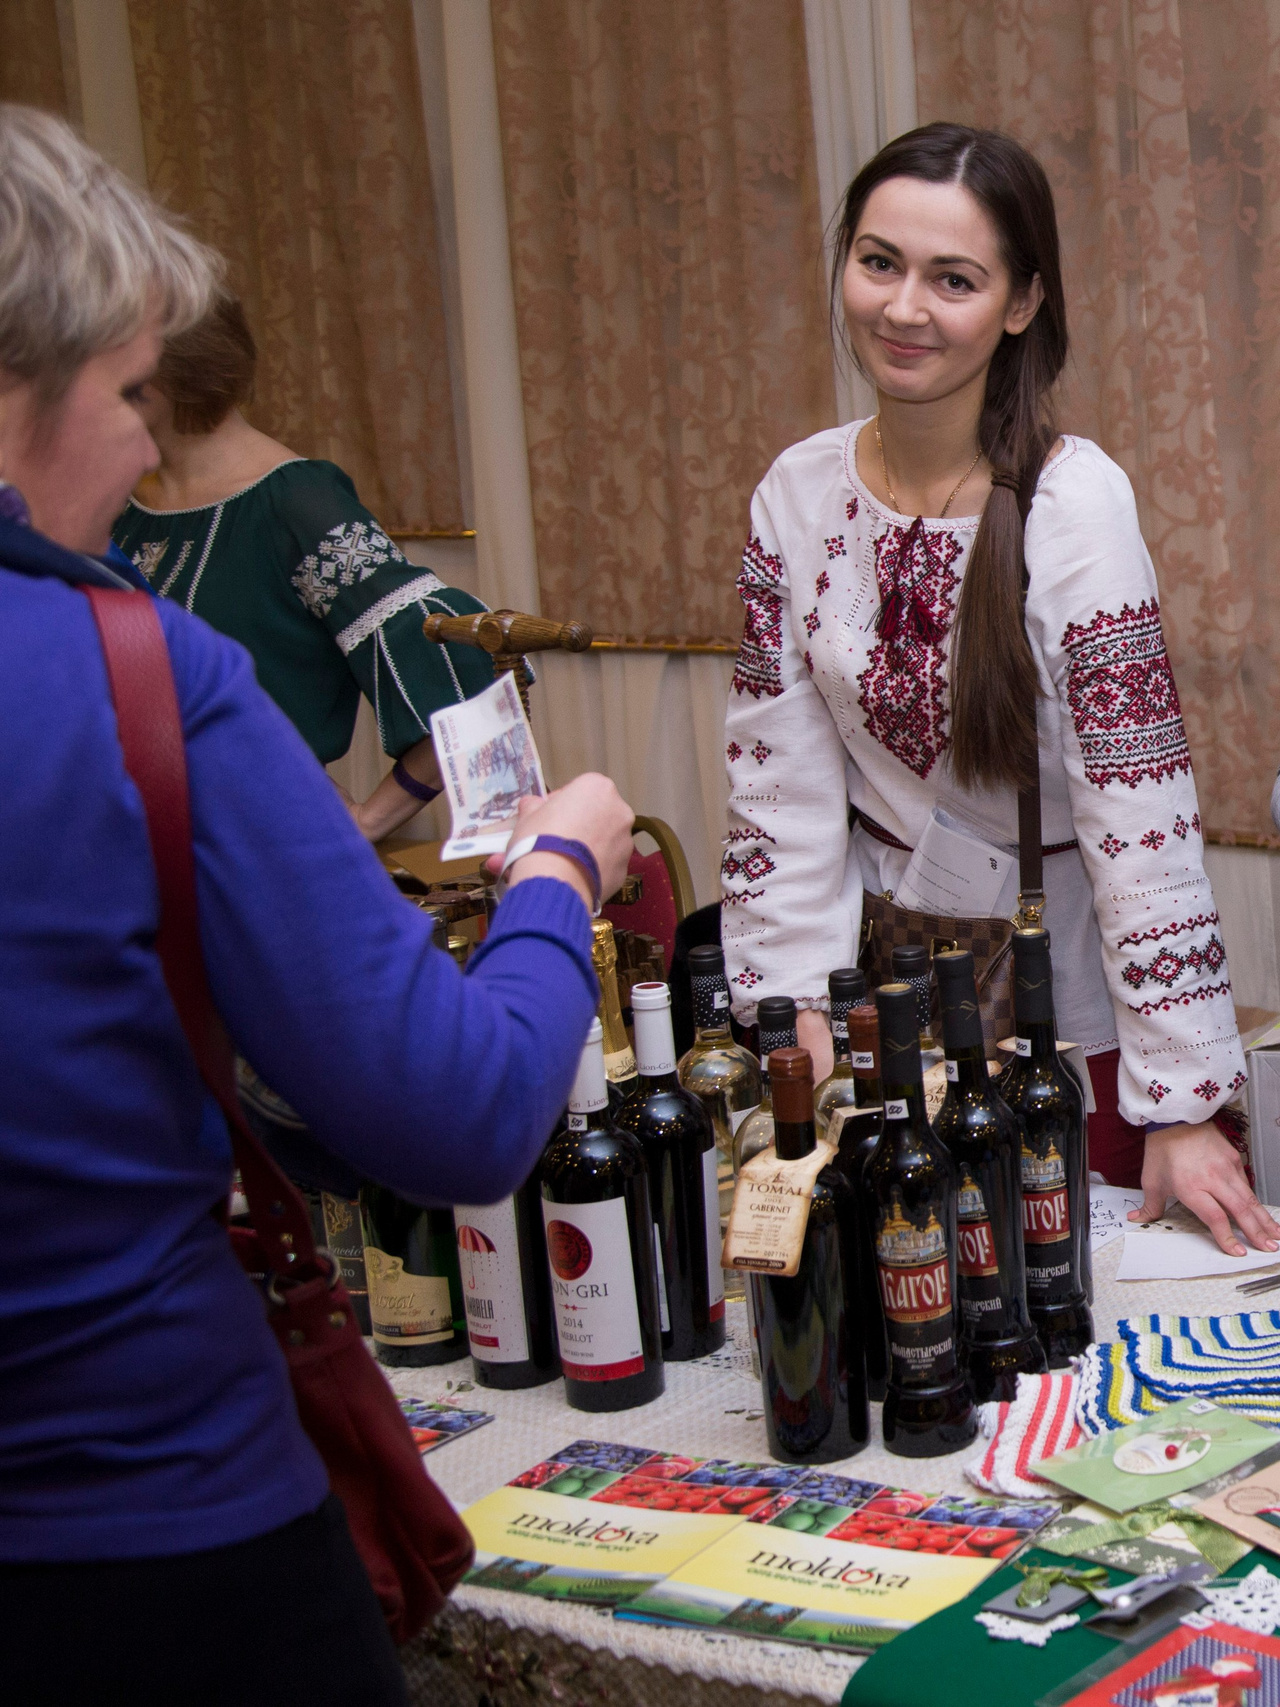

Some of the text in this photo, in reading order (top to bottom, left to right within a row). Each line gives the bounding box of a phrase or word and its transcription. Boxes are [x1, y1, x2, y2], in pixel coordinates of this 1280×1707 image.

[570, 1117, 583, 1128] 500
[748, 1183, 803, 1196] TOMAI
[749, 1203, 791, 1214] CABERNET
[1022, 1193, 1066, 1231] АГОР
[957, 1226, 989, 1265] ГОР
[563, 1316, 584, 1329] 2014
[561, 1330, 593, 1343] MERLOT
[575, 1367, 606, 1379] DOVA
[508, 1511, 660, 1546] moldova
[748, 1547, 911, 1590] moldova
